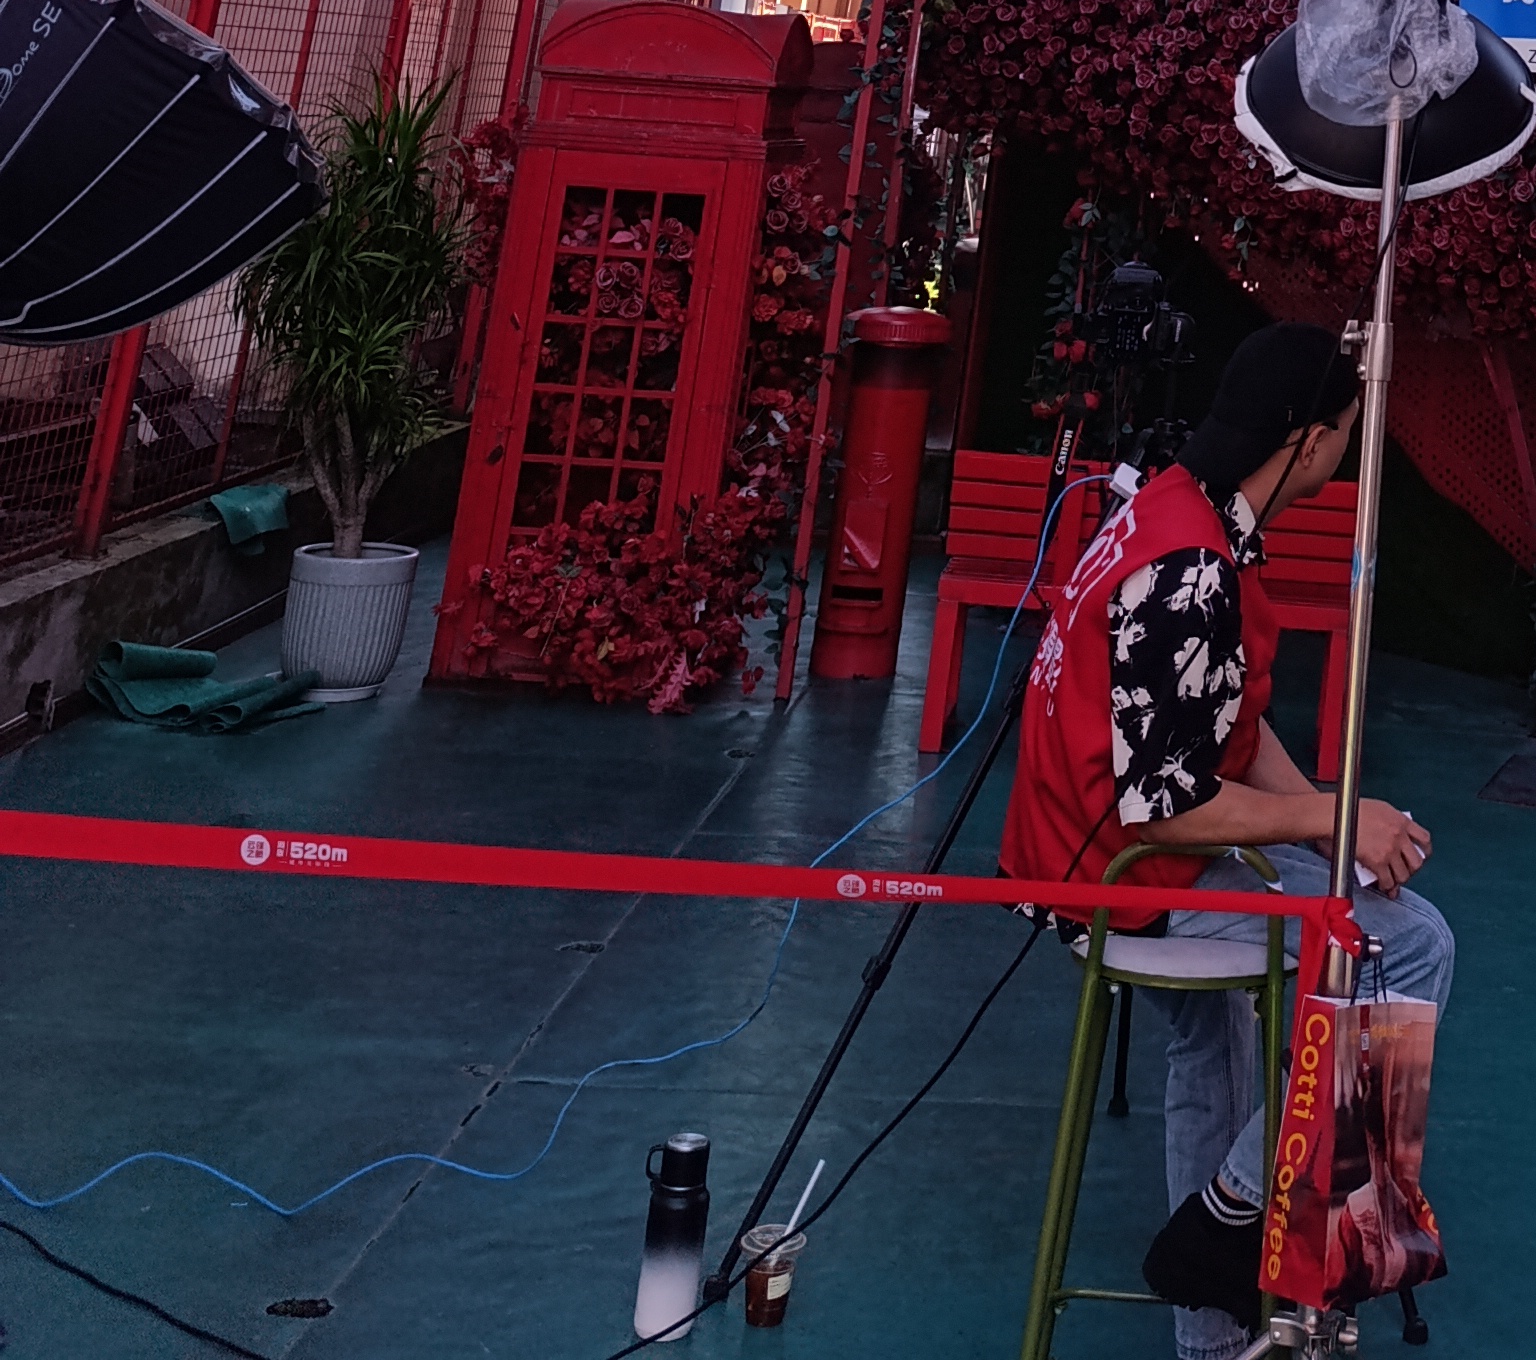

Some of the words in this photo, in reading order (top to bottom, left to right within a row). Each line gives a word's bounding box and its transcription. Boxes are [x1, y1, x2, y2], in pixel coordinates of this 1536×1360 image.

[33, 1, 62, 39] SE
[1055, 429, 1074, 476] Canon
[290, 841, 348, 862] 520m
[886, 880, 943, 897] 520m
[1292, 1013, 1331, 1122] Cotti
[1268, 1132, 1307, 1281] Coffee
